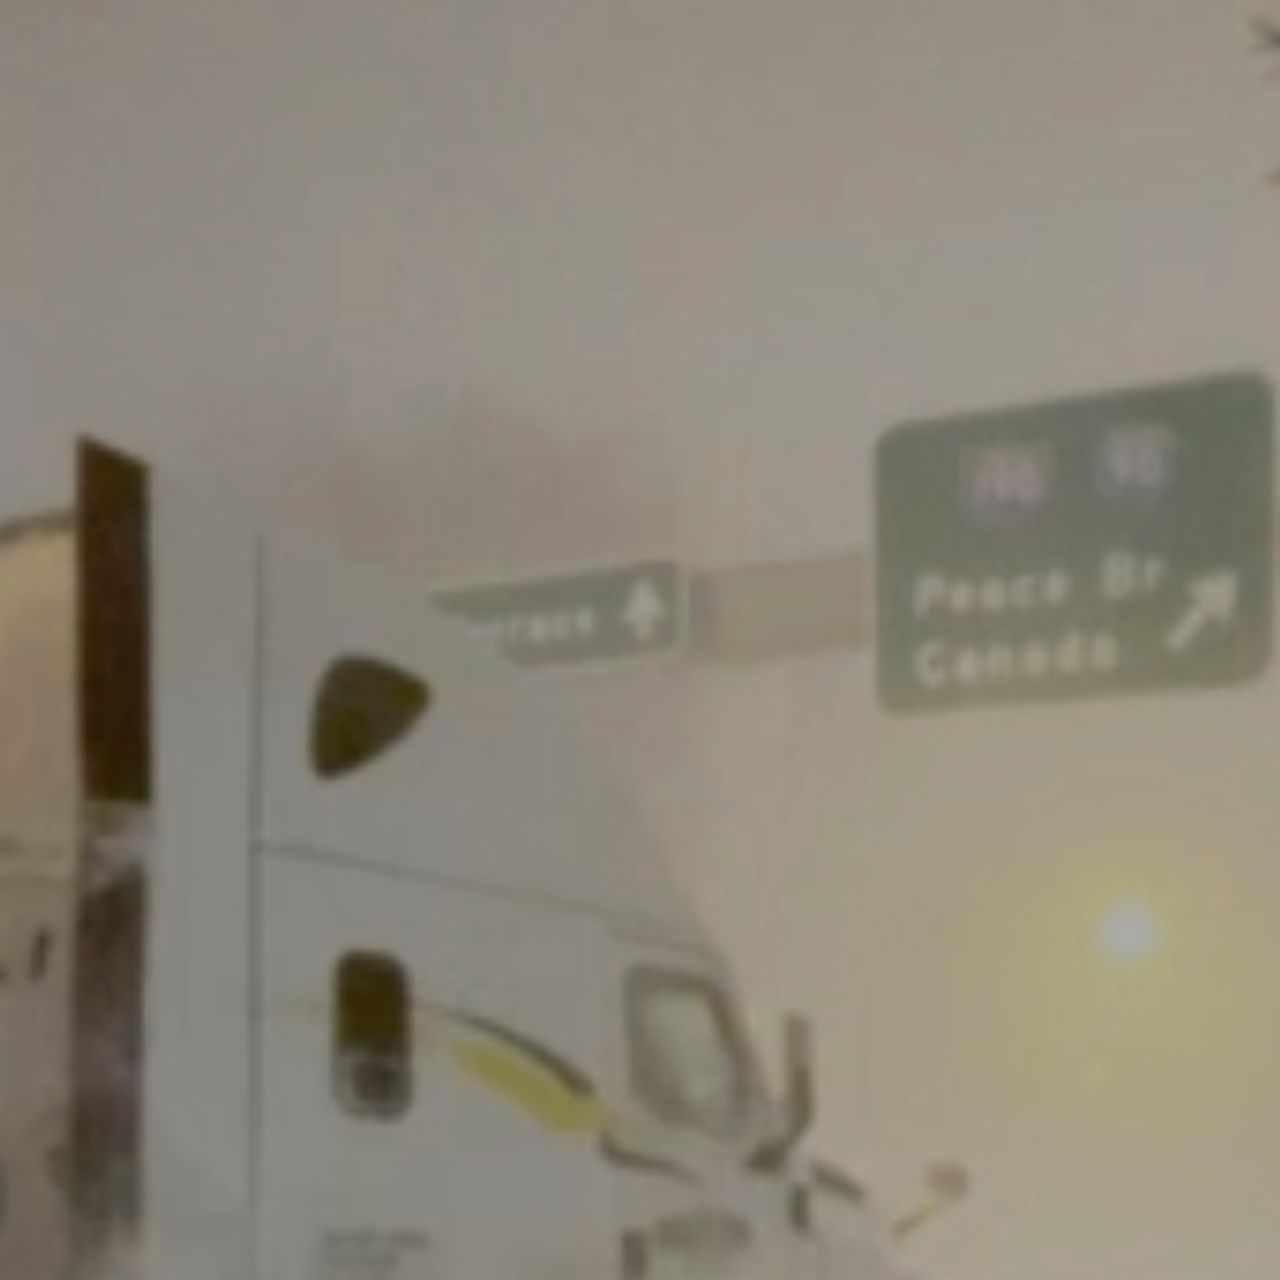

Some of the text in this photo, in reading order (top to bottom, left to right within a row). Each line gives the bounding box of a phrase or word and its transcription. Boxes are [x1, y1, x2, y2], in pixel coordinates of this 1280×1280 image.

[916, 549, 1166, 619] Peace Br
[916, 629, 1118, 687] Canada
